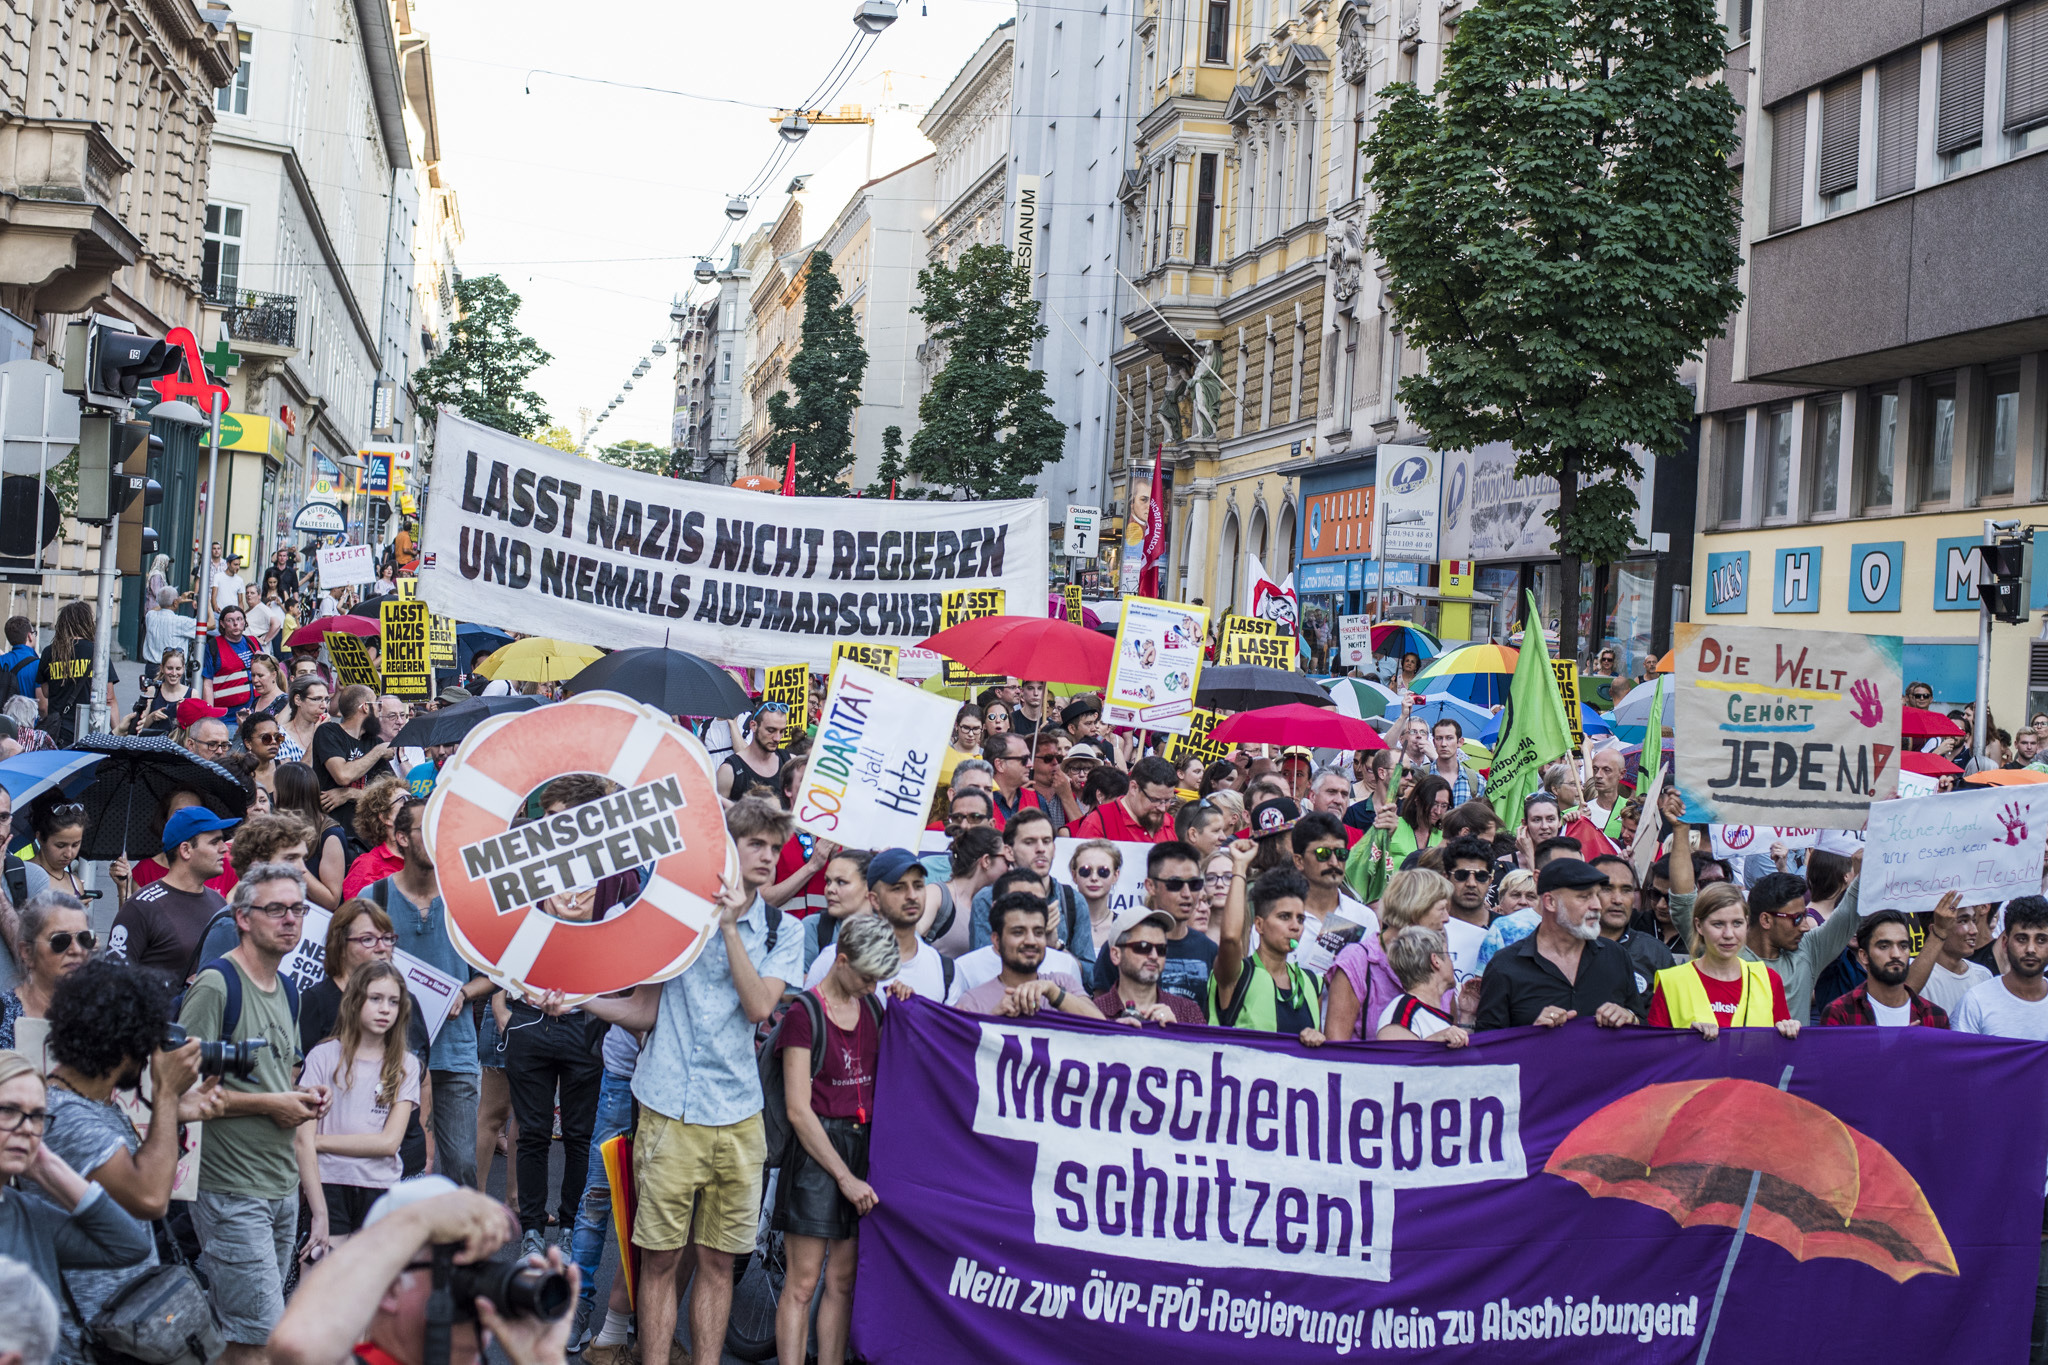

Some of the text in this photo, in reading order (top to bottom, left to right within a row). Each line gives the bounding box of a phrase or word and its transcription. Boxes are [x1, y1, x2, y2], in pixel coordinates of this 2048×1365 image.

[131, 350, 140, 359] 19
[374, 387, 384, 429] KIESER
[384, 387, 393, 429] TRAINING
[132, 479, 142, 488] 12
[306, 507, 336, 517] AUTOBUS
[461, 450, 1008, 580] LASST NAZIS NICHT REGIEREN
[1070, 507, 1097, 515] COLUMBUS
[300, 520, 340, 529] HALTESTELLE
[324, 547, 366, 564] RESPEKT
[459, 526, 532, 589] UND
[540, 547, 691, 618] NIEMALS
[1712, 557, 1742, 608] M&S
[947, 592, 998, 610] LASST
[385, 604, 424, 622] LASST
[386, 622, 425, 641] NAZIS
[1230, 618, 1271, 635] LASST
[326, 635, 361, 651] LASST
[386, 642, 425, 660] NICHT
[1238, 638, 1288, 656] LASST
[333, 651, 369, 668] NAZIS
[838, 645, 893, 665] LASST
[1239, 654, 1288, 671] NAZIS
[339, 667, 376, 684] NICHT
[386, 661, 425, 673] REGIEREN
[1776, 643, 1847, 690] WELT
[386, 677, 426, 686] UND NIEMALS
[768, 666, 805, 688] LASST
[768, 686, 805, 706] NAZIS
[1727, 694, 1813, 723] GEHÖRT
[800, 674, 874, 831] SOLIDARITÄT
[1708, 739, 1895, 797] JEDEM!
[875, 750, 928, 816] Hetze
[461, 777, 684, 877] MENSCHEN
[1880, 815, 1933, 842] Keine
[489, 815, 682, 912] RETTEN!
[1882, 852, 1908, 864] wir
[1919, 845, 1956, 860] essen
[1883, 868, 1961, 896] Menschen
[411, 971, 449, 994] junge linke
[997, 1034, 1504, 1171] Menschenleben
[1054, 1148, 1372, 1261] schützen!
[949, 1257, 1698, 1355] Nein zur ÖVP-FPÖ-Regierung! Nein zu Abschiebungen!
